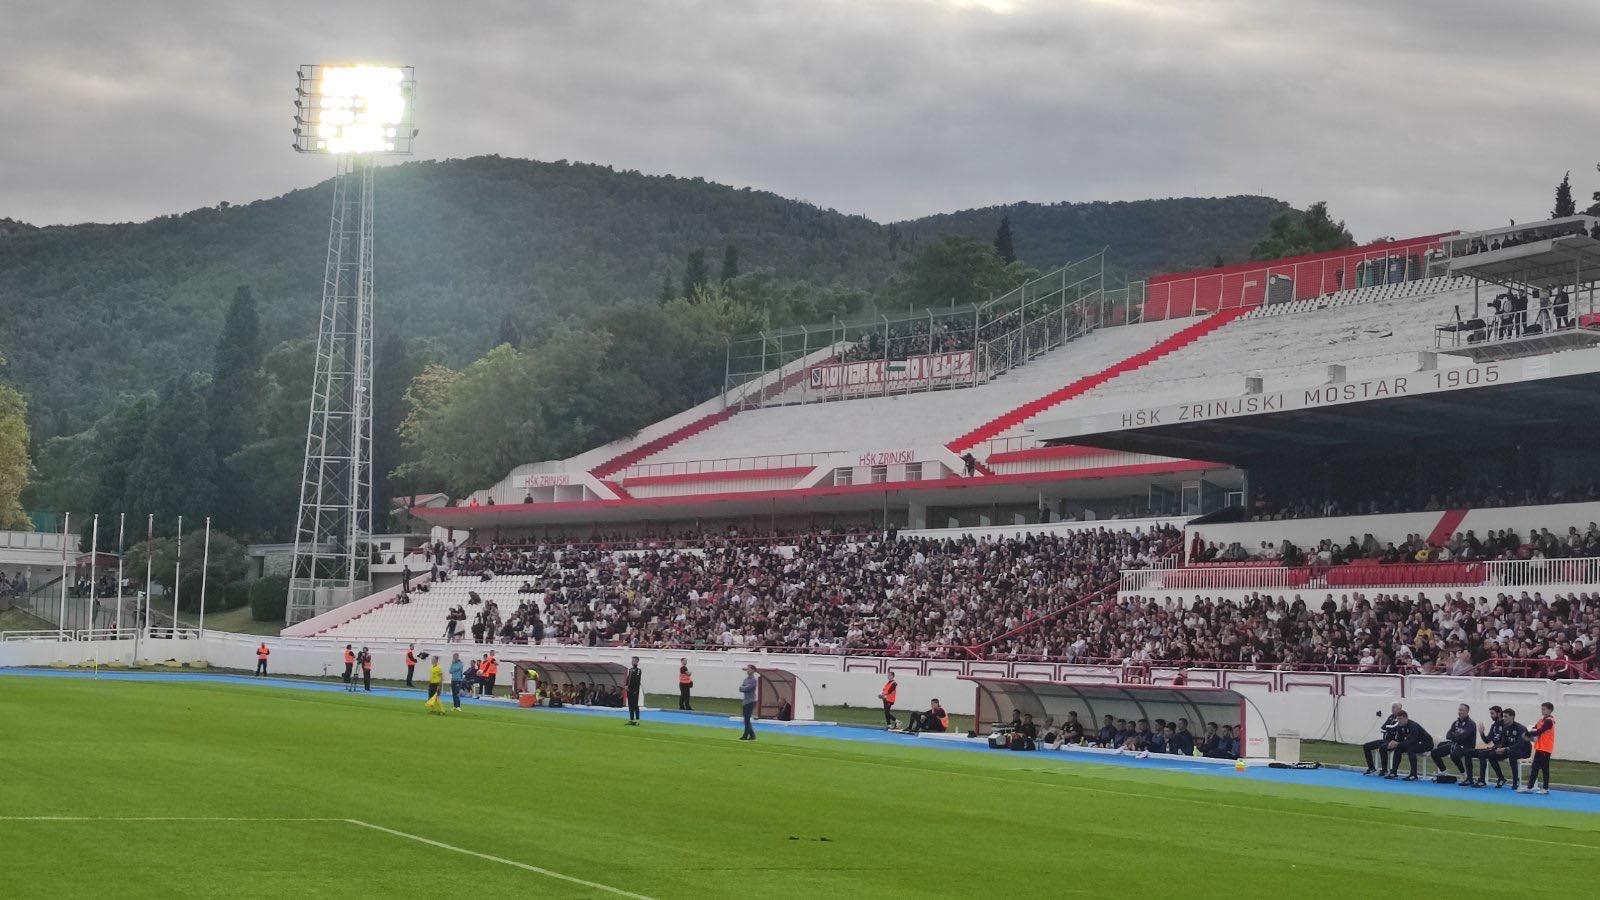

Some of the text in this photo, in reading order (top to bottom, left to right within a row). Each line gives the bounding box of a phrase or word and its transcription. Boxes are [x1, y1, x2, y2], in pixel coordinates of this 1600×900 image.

[1122, 365, 1499, 427] HŠK ZRINJSKI MOSTAR 1905
[878, 450, 914, 464] ZRINJSKI
